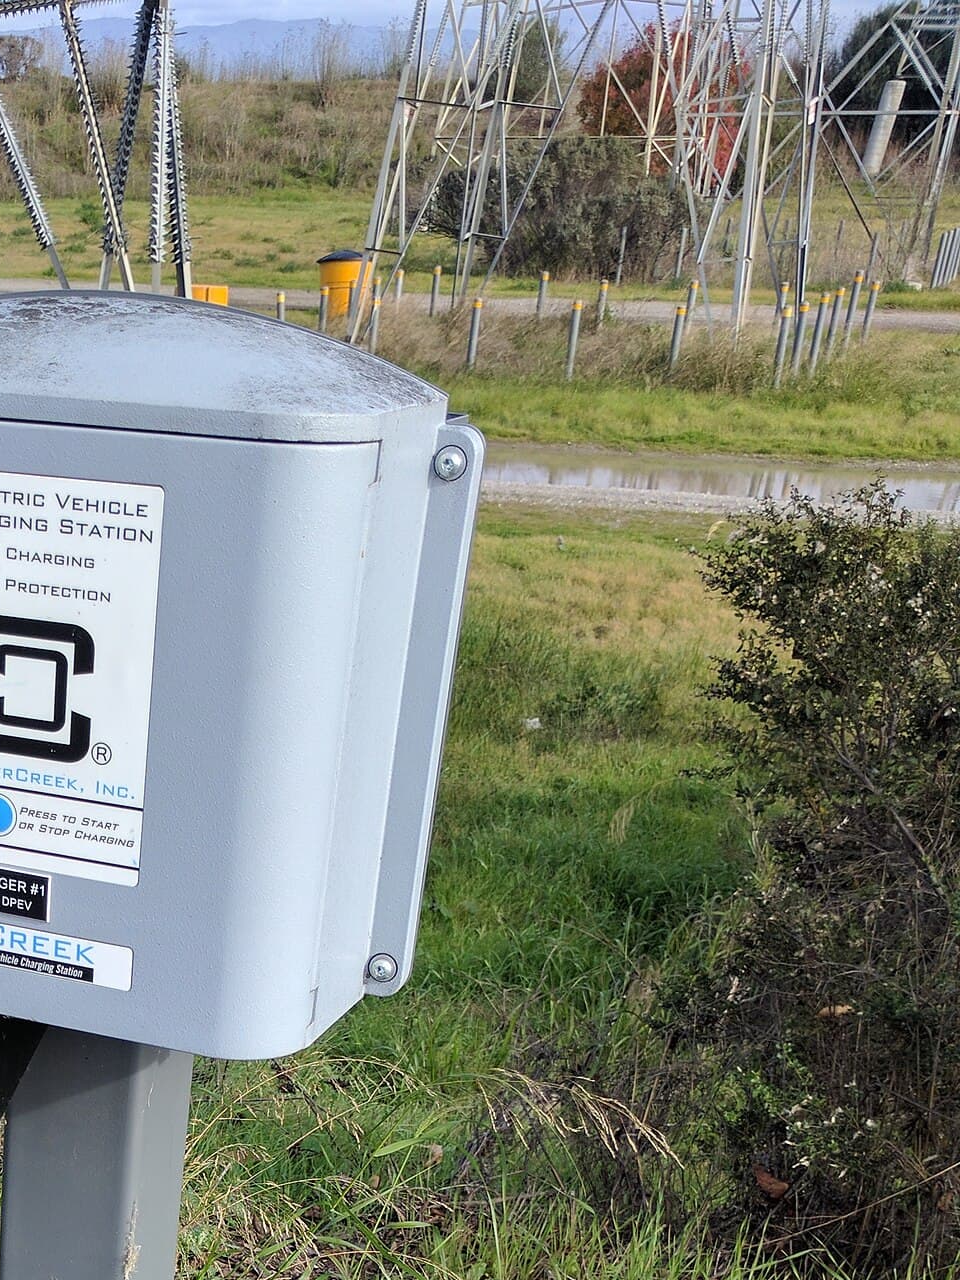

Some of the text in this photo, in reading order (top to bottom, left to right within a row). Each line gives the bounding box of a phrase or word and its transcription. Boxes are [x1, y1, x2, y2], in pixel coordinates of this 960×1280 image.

[56, 493, 148, 517] VEHICLE
[59, 519, 153, 543] STATION
[5, 547, 96, 569] CHARGING
[5, 578, 111, 603] PROTECTION
[95, 780, 135, 800] INC.
[19, 806, 120, 832] PRESS TO START
[18, 821, 135, 849] OR STOP CHARGING
[29, 882, 46, 898] #1
[1, 895, 33, 912] DPEV
[20, 956, 55, 975] Charging
[55, 963, 84, 979] Station
